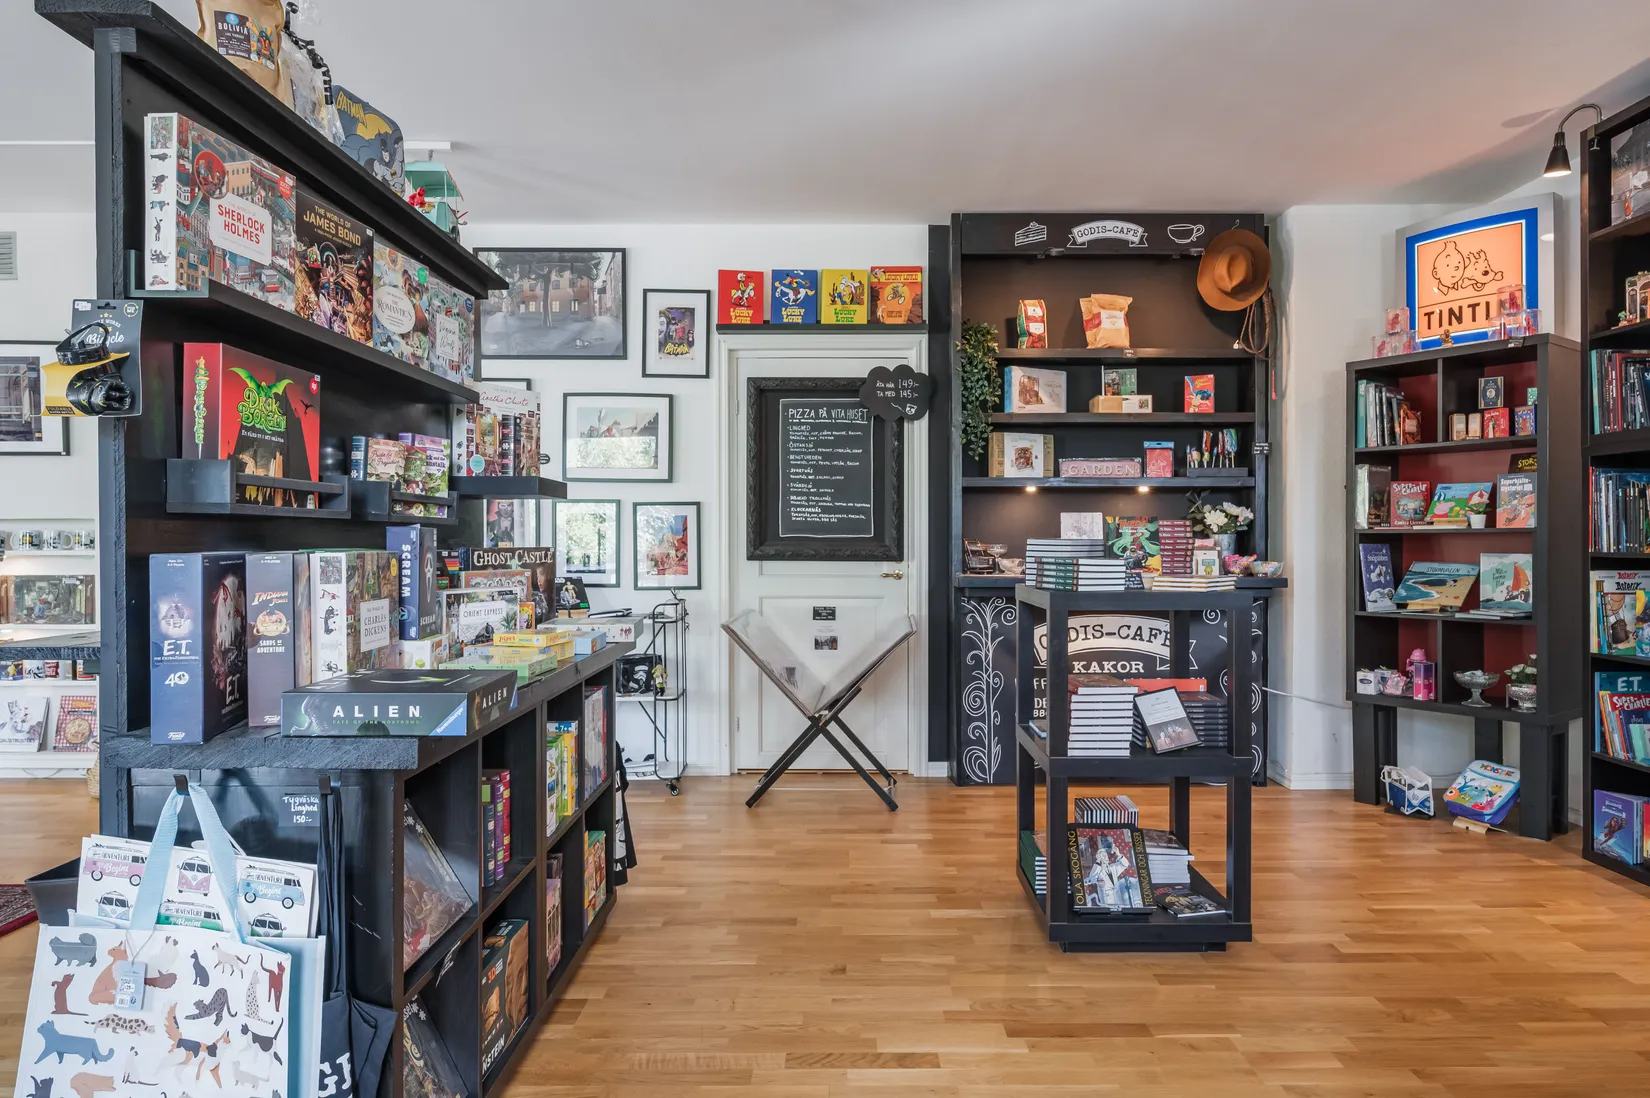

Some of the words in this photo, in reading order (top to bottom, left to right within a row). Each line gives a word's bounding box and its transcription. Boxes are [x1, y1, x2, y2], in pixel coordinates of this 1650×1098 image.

[218, 22, 249, 35] BOLIVIA
[336, 91, 368, 129] BATMAN
[217, 204, 265, 235] SHERLOCK
[314, 205, 326, 217] THE
[326, 211, 344, 225] WORLD
[344, 219, 352, 229] OF
[223, 219, 261, 245] HOLMES
[303, 210, 336, 235] JAMES
[338, 228, 361, 247] BOND
[1076, 225, 1140, 239] GODIS-CAFÉ
[729, 308, 753, 317] LUCKY
[781, 307, 805, 316] LUCKY
[834, 308, 857, 316] LUCKY
[1424, 300, 1491, 331] TINTI
[731, 316, 751, 324] LUKE
[783, 315, 802, 323] LUKE
[835, 315, 854, 323] LUKE
[664, 343, 690, 355] BATMAN
[788, 408, 816, 419] PIZZA
[819, 406, 828, 419] PÅ
[830, 408, 846, 419] VITA
[846, 408, 869, 421] HUSET
[1068, 464, 1136, 476] GARDEN
[473, 549, 512, 566] GHOST
[515, 549, 554, 565] CASTLE
[401, 544, 411, 597] SCREAM
[1617, 572, 1640, 580] Asterix
[1615, 581, 1643, 592] Asterix
[463, 608, 483, 618] ORIENT
[484, 607, 504, 617] EXPRESS
[364, 614, 387, 626] CHARLES
[420, 614, 436, 625] SCREAM
[364, 624, 387, 637] DICKENS
[163, 639, 193, 656] E.T.
[257, 646, 285, 654] ADVENTURE
[1072, 661, 1145, 674] KAKOR
[226, 673, 240, 705] E.T.
[1617, 676, 1643, 692] E.T.
[482, 687, 508, 708] ALIEN
[333, 705, 421, 718] ALIEN
[291, 803, 318, 815] Linghed
[293, 815, 312, 824] 150:-
[1133, 831, 1145, 853] SKISSER
[1137, 854, 1147, 868] OCH
[1076, 881, 1085, 905] OLA
[1139, 869, 1153, 905] TECKNINGAR
[481, 1034, 505, 1076] NSTEIN
